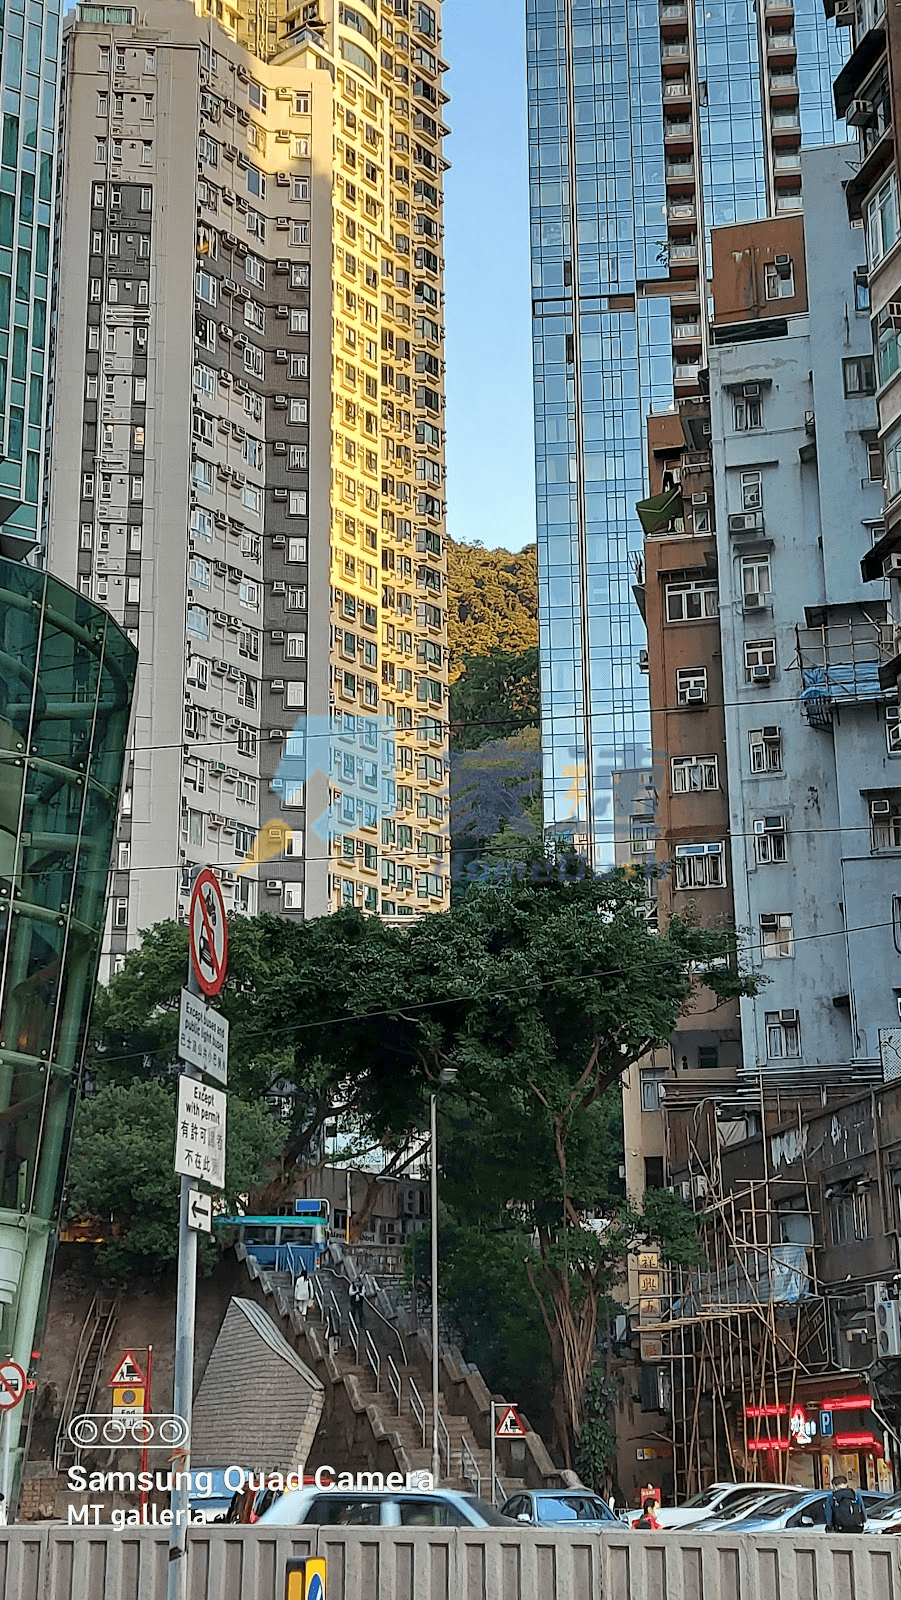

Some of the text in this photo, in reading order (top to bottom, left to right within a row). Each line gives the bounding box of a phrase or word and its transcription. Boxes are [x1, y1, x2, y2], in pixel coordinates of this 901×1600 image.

[185, 1001, 225, 1039] Except buses and
[184, 1019, 224, 1053] public light buses
[193, 1086, 215, 1108] Except
[185, 1101, 221, 1126] with permit
[640, 1254, 659, 1358] 祥興五
[822, 1412, 830, 1434] P
